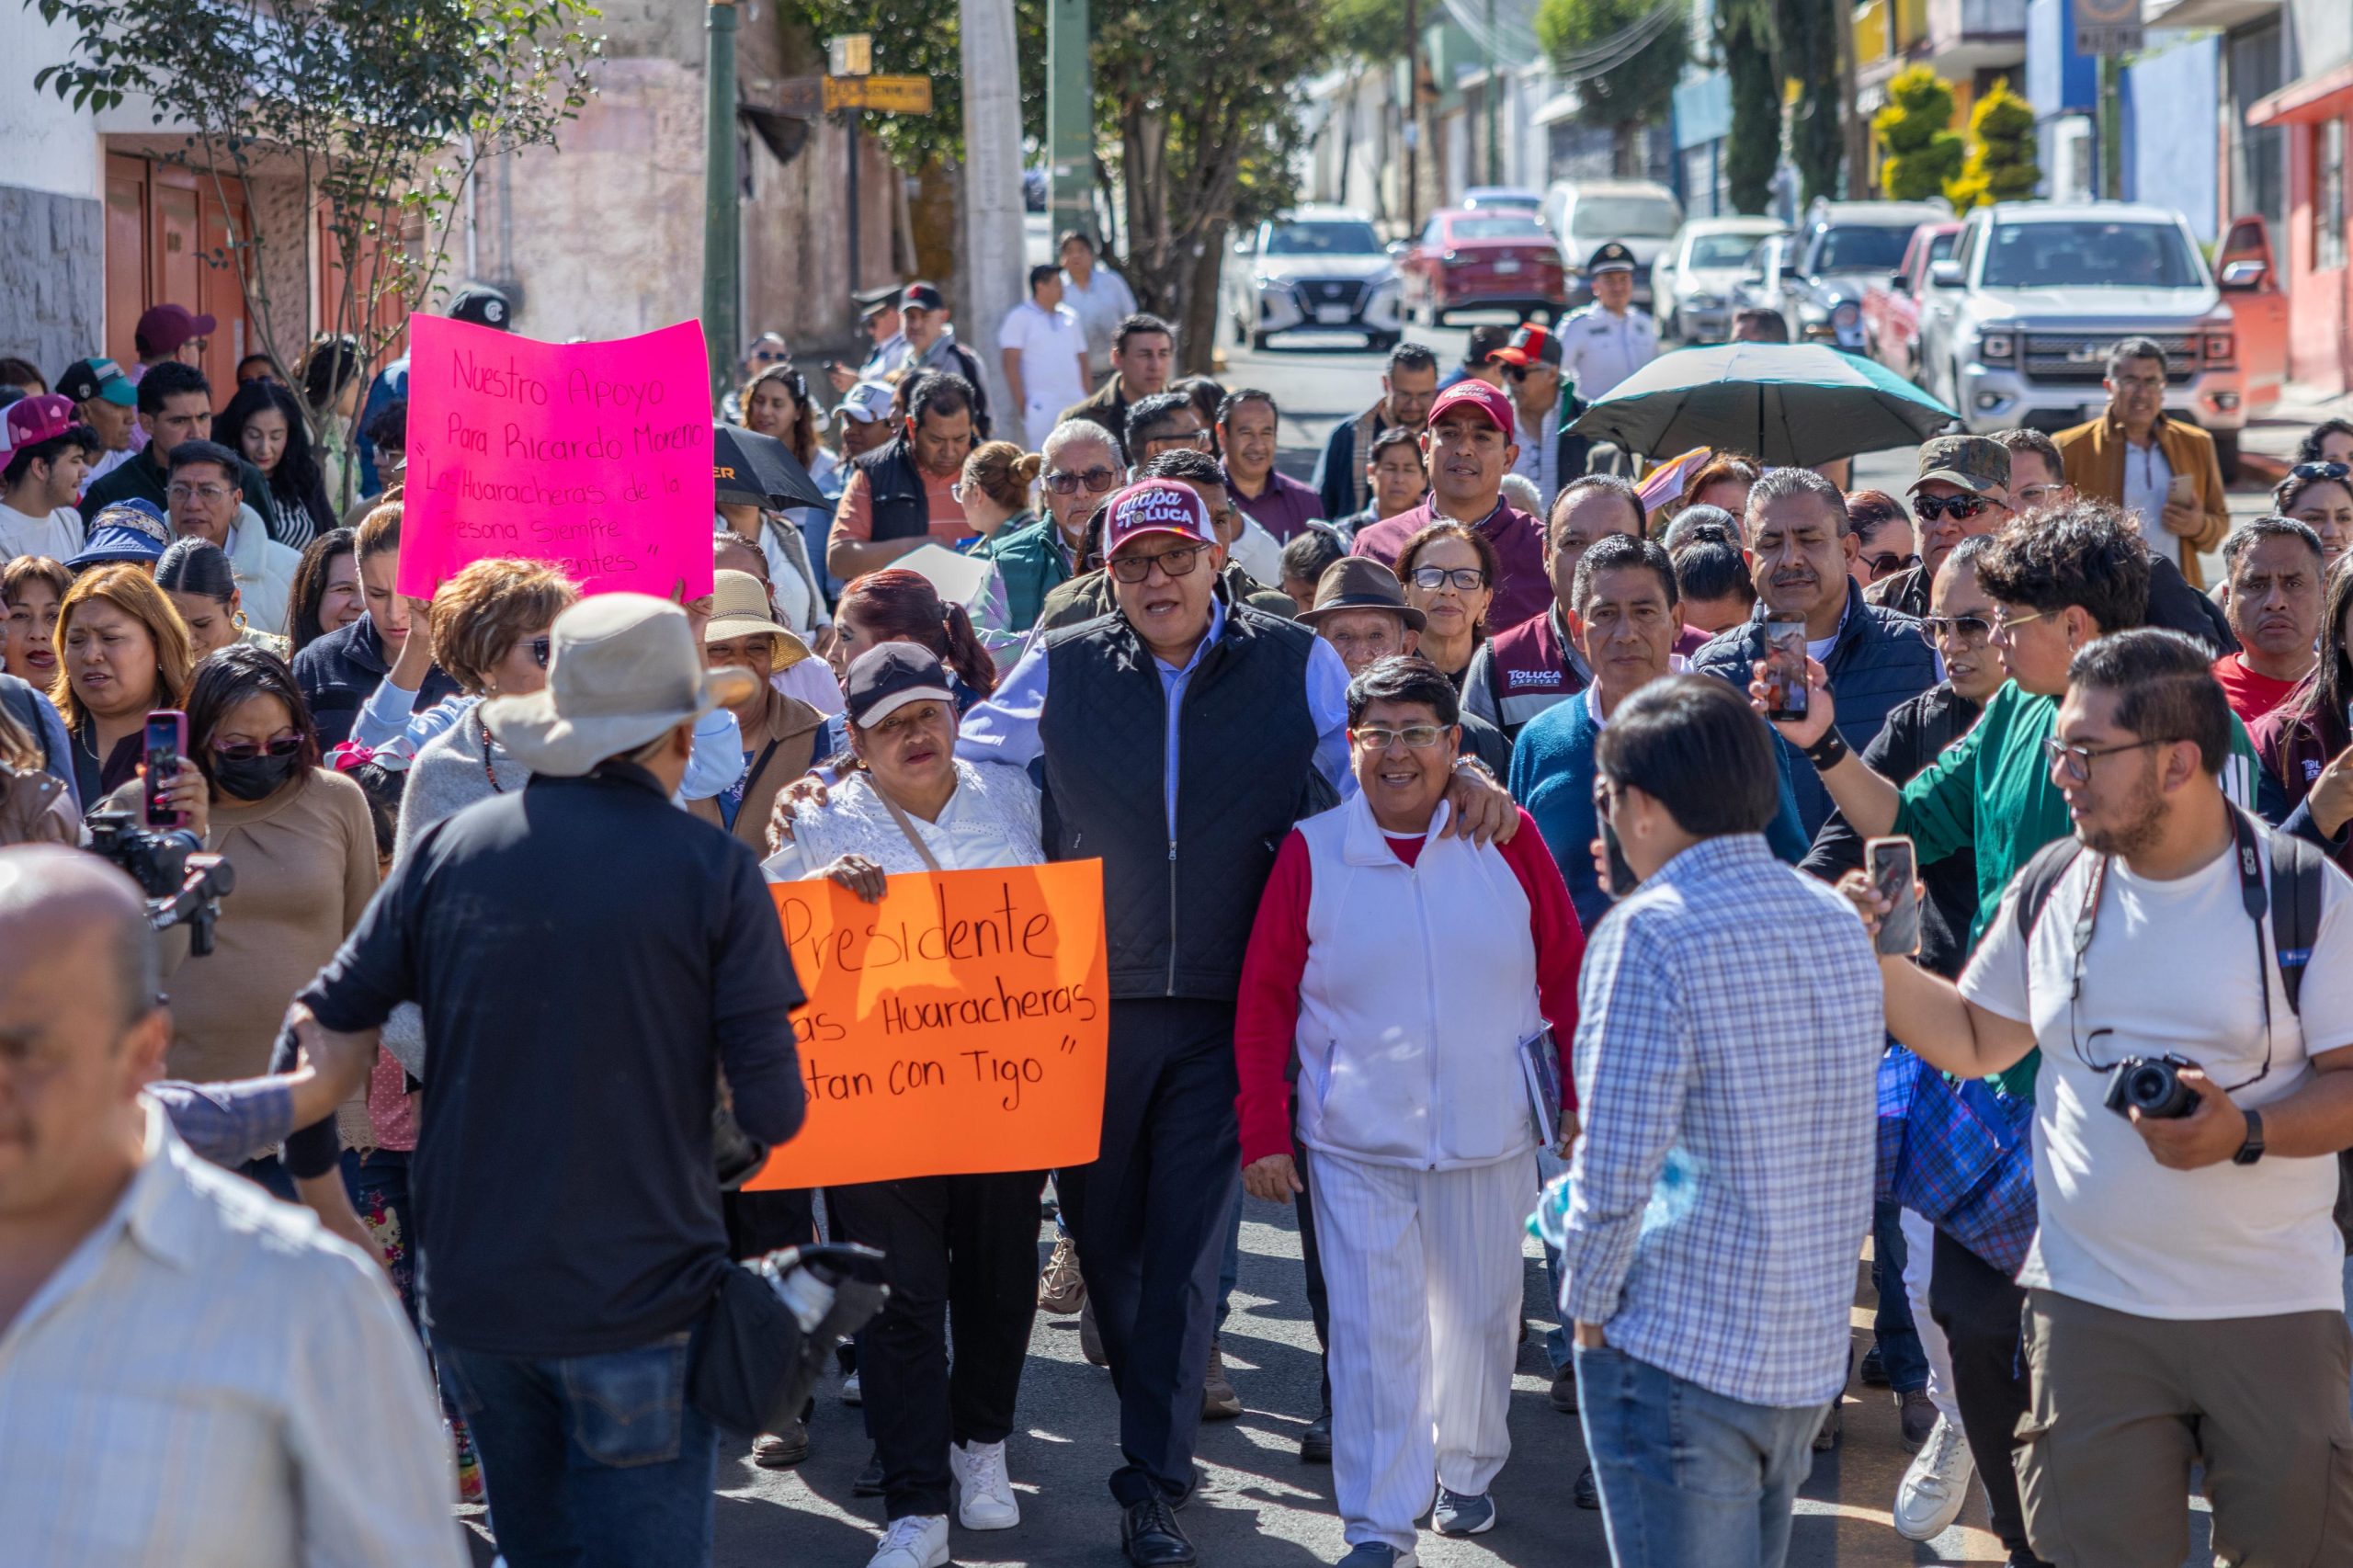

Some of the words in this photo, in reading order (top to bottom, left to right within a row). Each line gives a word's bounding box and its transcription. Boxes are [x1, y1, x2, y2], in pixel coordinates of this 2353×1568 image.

[453, 348, 547, 405] Nuestro
[448, 412, 488, 457] Para
[506, 423, 623, 461] Ricardo
[633, 422, 704, 455] Moreno
[462, 470, 606, 506] Huaracheras
[624, 473, 651, 503] de
[662, 472, 680, 494] la
[1116, 491, 1182, 521] guapa
[1118, 507, 1194, 528] TOLUCA
[1507, 669, 1562, 681] TOLUCA
[2242, 846, 2257, 876] EOS
[781, 882, 1053, 971] Presidente
[791, 1013, 847, 1043] as
[883, 976, 1097, 1035] Huaracheras
[889, 1060, 945, 1096] con
